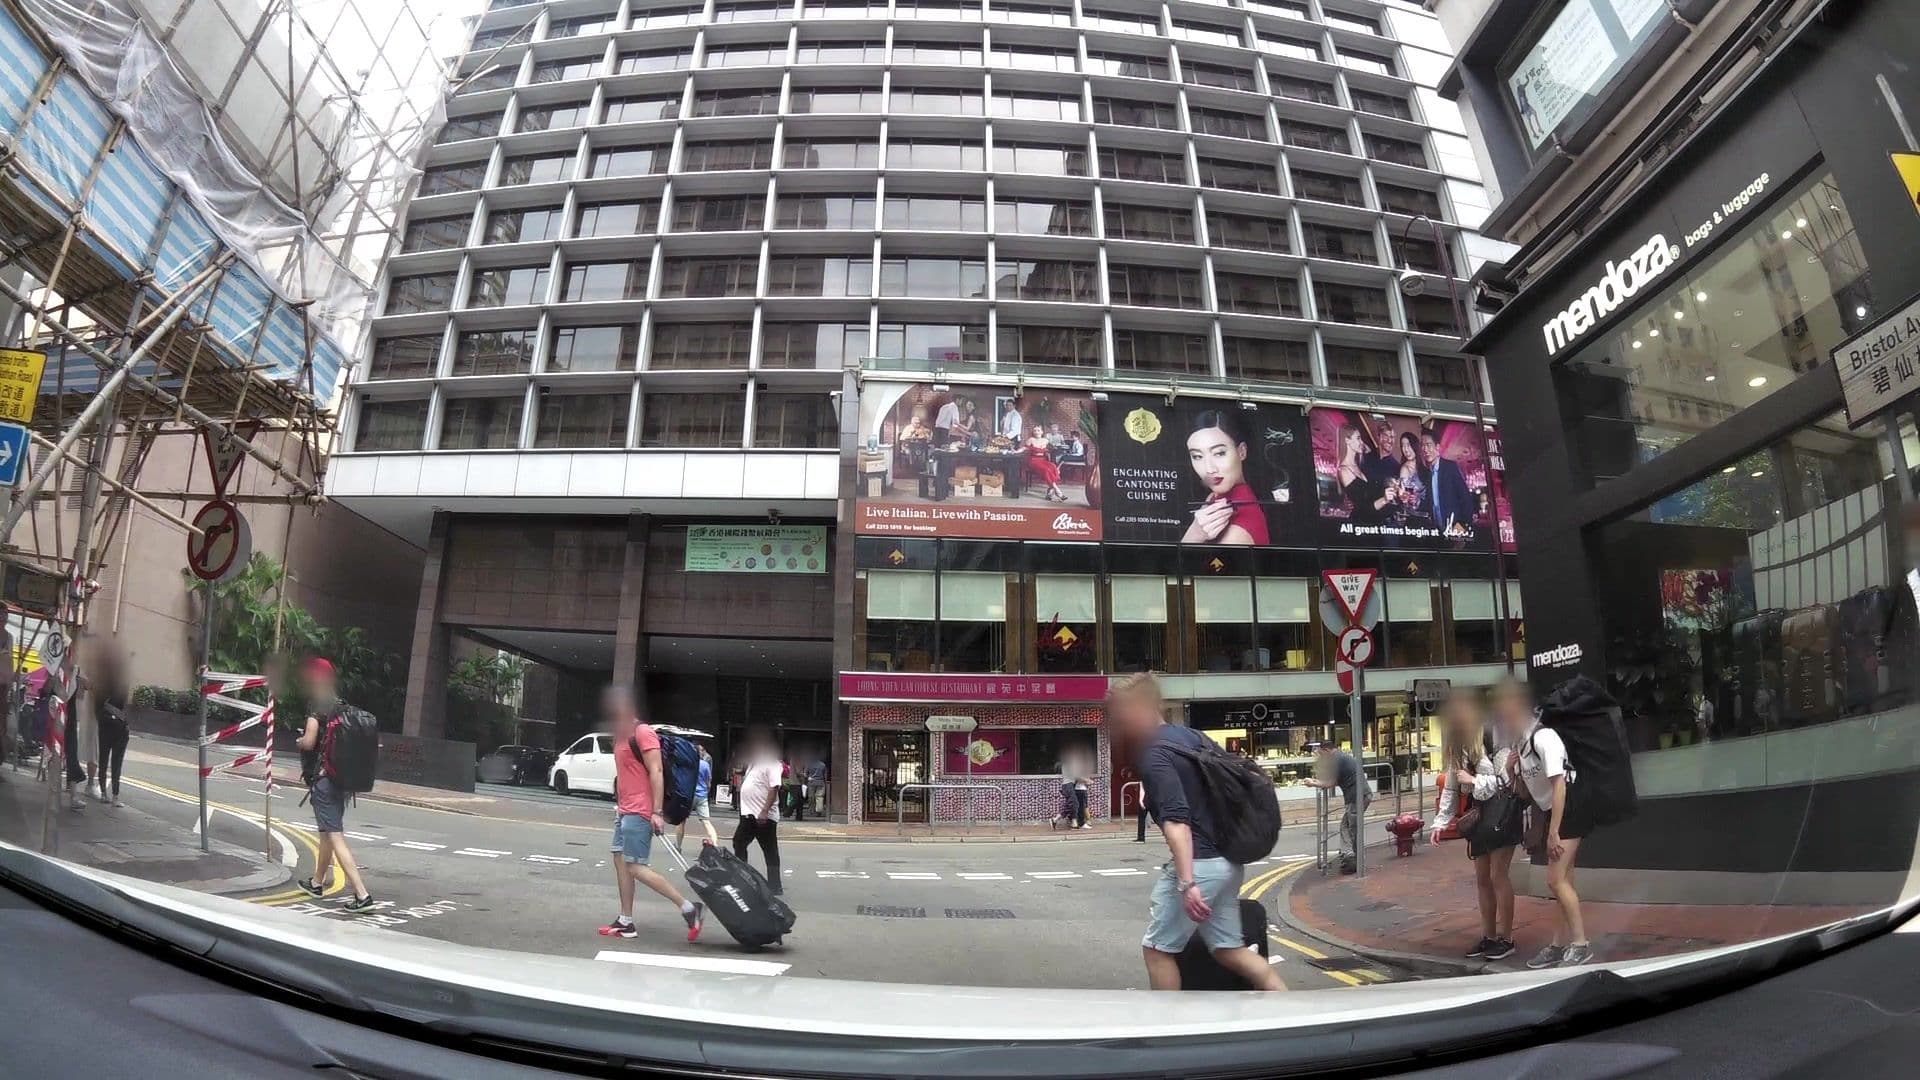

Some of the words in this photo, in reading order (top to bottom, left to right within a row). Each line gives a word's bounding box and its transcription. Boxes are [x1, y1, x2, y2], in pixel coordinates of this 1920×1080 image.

[1685, 220, 1713, 247] bags
[1713, 211, 1723, 224] &
[1722, 172, 1770, 216] luggage
[1850, 326, 1902, 370] Bristol
[1113, 467, 1178, 479] ENCHANTING
[1116, 479, 1176, 490] CANTONESE
[1127, 491, 1168, 501] CUISINE
[866, 507, 889, 518] Live
[892, 507, 930, 519] Italian.
[983, 510, 1028, 522] Passion.
[1340, 523, 1353, 533] All
[1355, 525, 1379, 536] great
[1380, 525, 1404, 535] times
[1405, 526, 1430, 538] begin
[1430, 528, 1440, 537] at
[1341, 576, 1361, 584] GIVE
[1342, 584, 1360, 592] WAY
